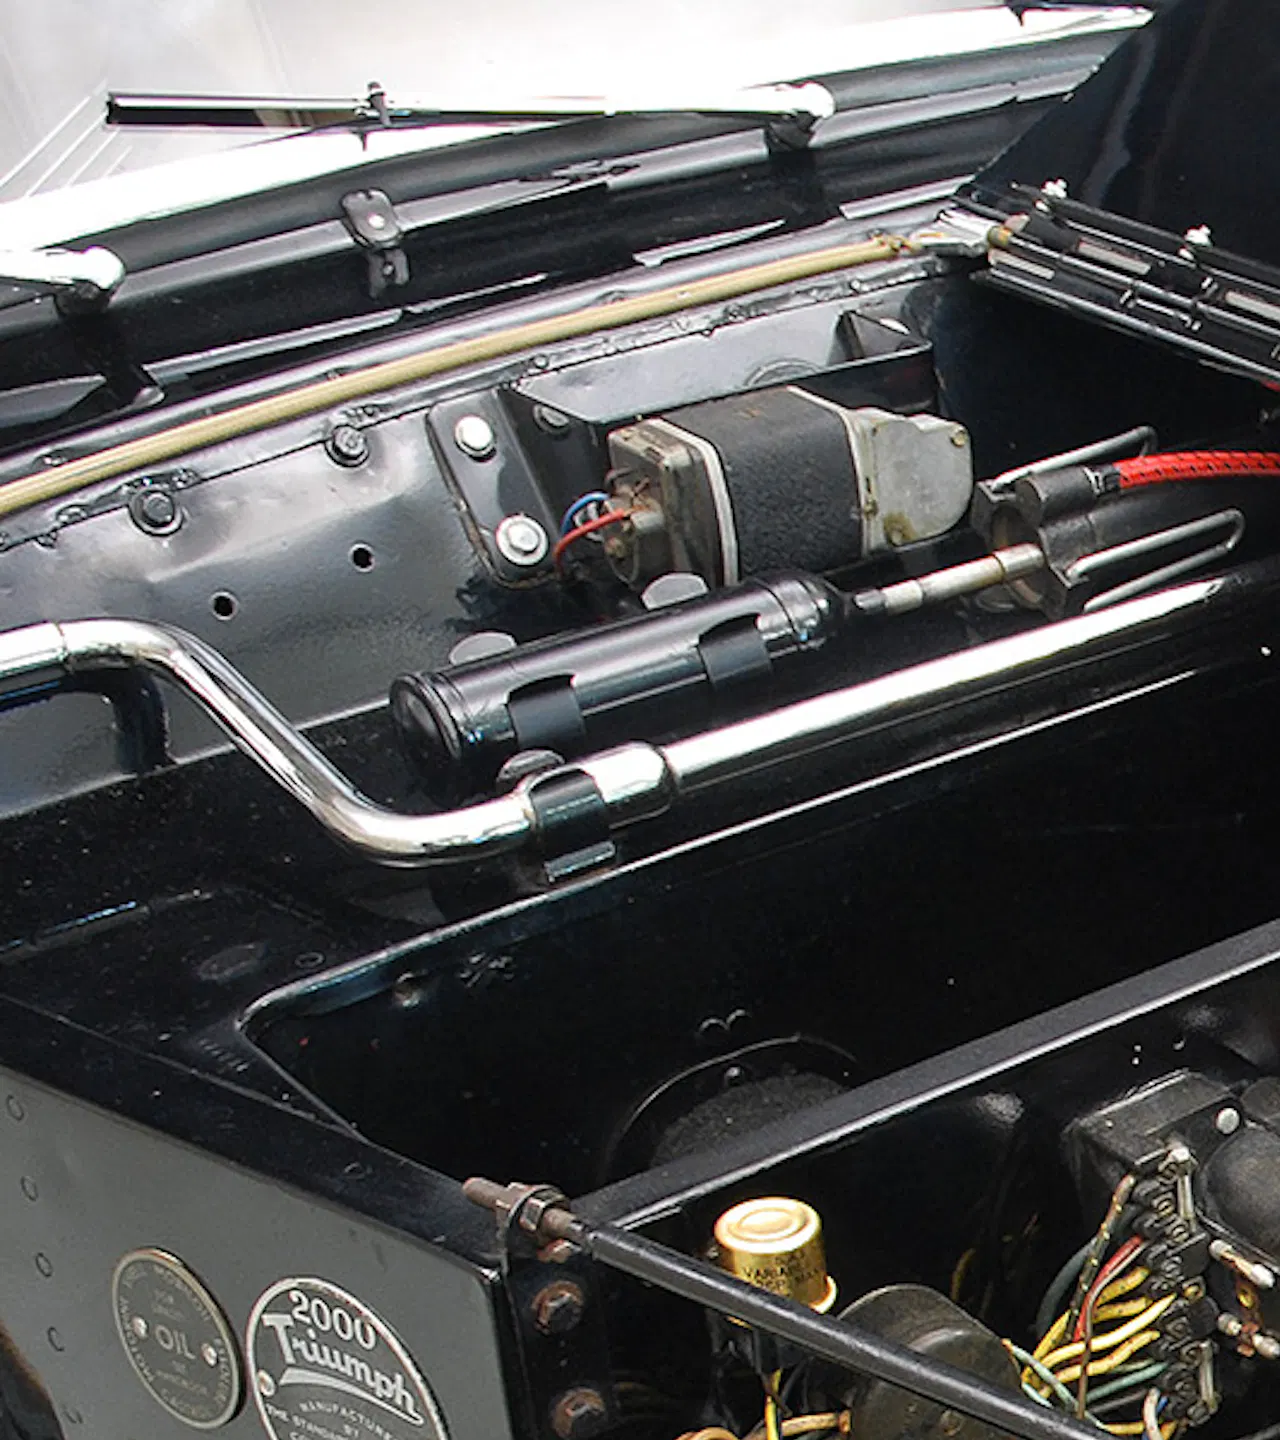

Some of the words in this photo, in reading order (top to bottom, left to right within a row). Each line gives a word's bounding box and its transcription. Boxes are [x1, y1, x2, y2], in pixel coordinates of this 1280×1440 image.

[154, 1324, 196, 1361] OIL
[288, 1289, 377, 1351] 2000
[261, 1312, 421, 1423] Triumph
